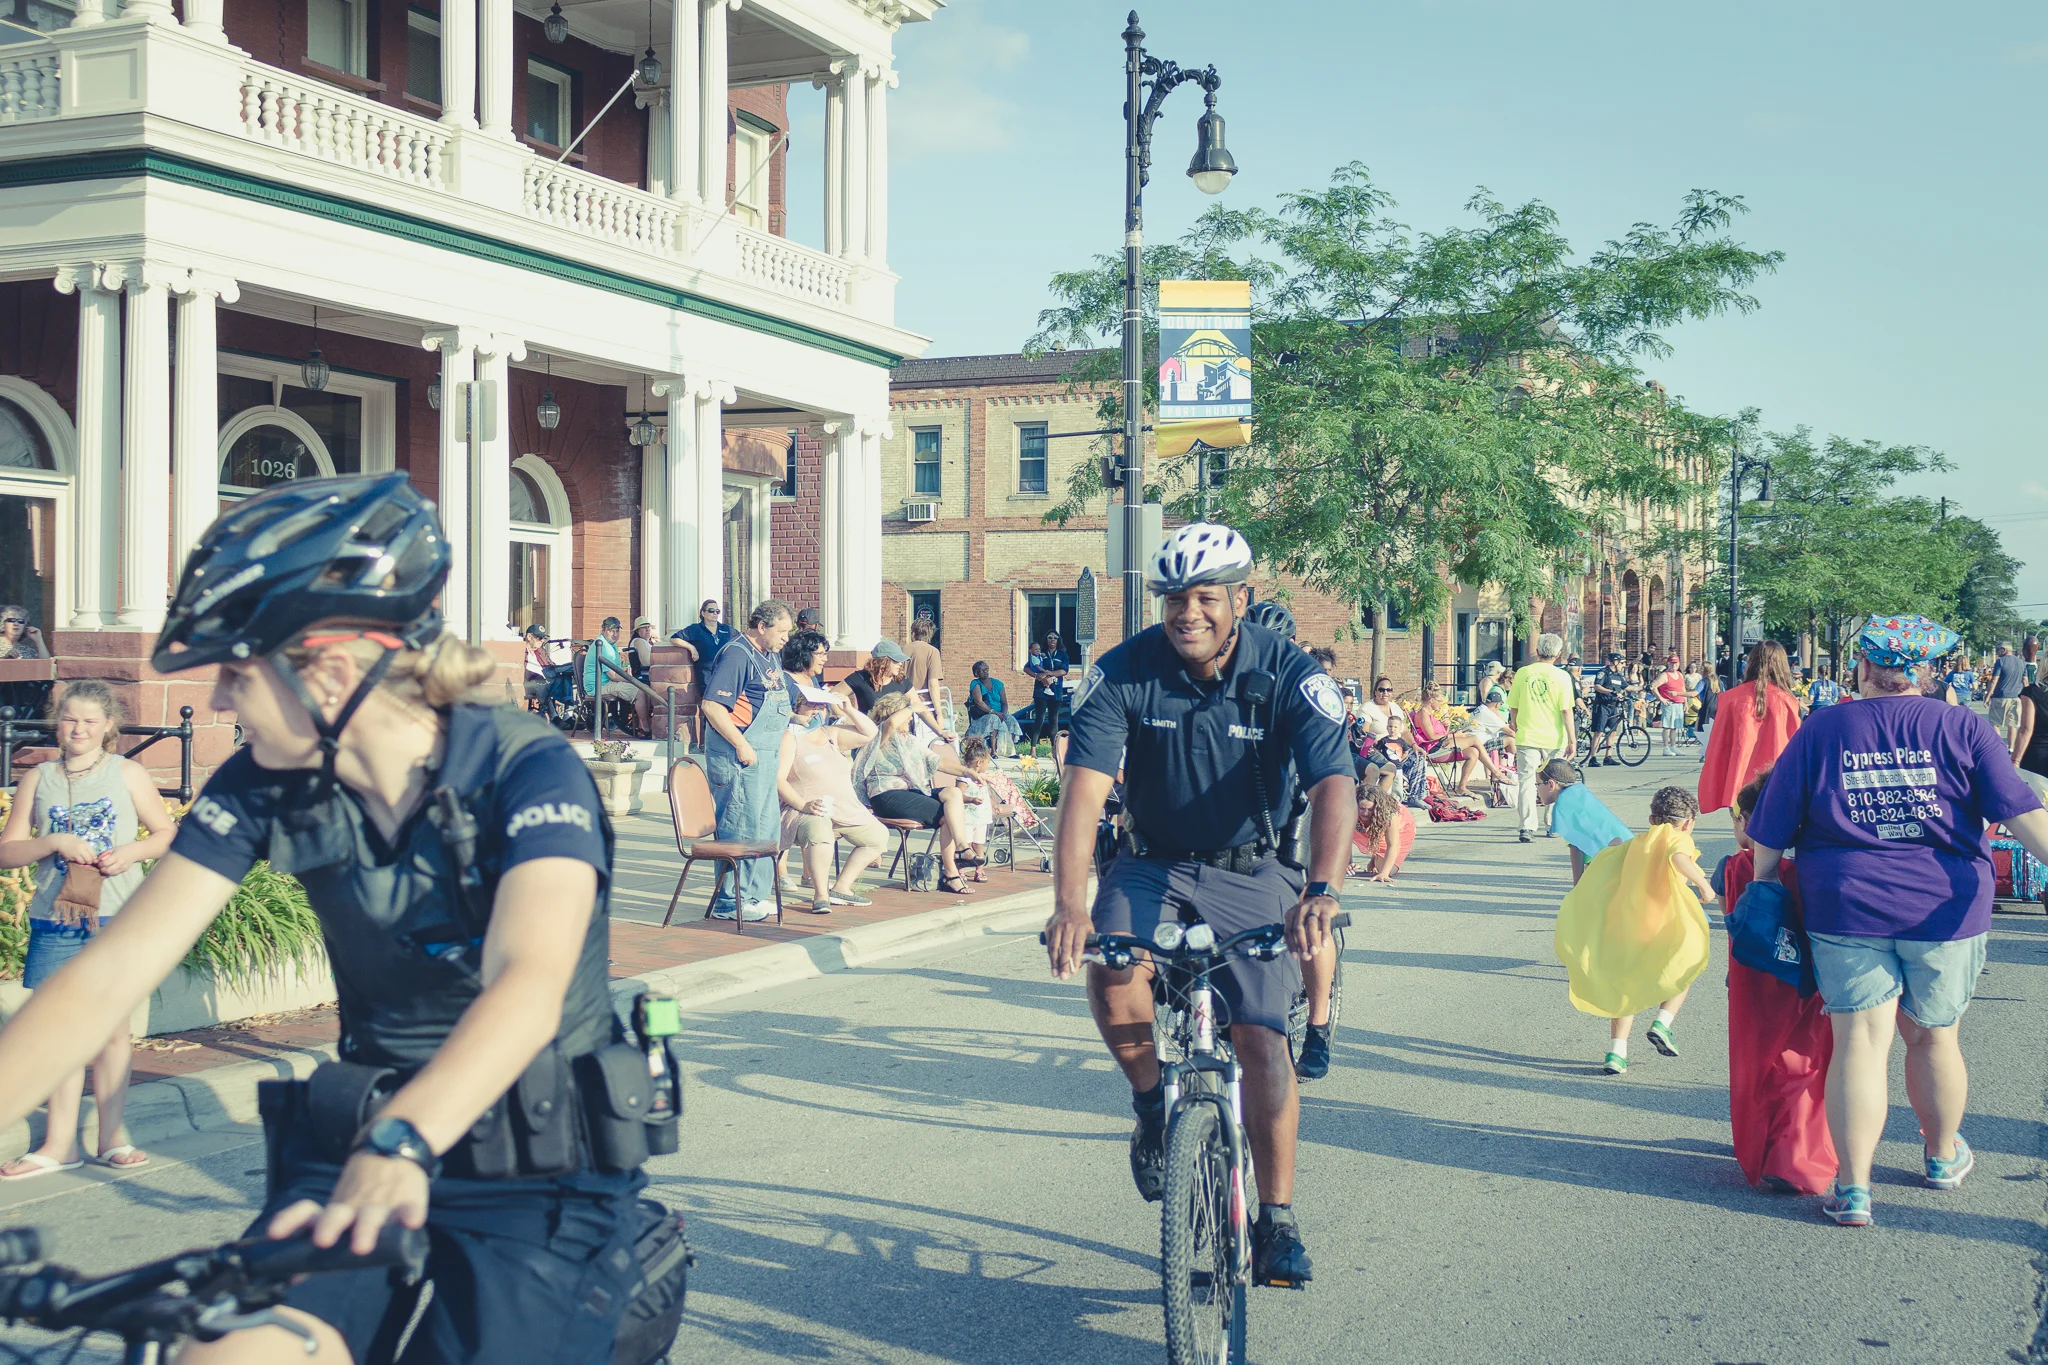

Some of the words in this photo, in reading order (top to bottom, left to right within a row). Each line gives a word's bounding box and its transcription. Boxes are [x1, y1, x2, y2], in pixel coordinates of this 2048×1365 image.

[1167, 316, 1243, 329] DOWNTOWN
[1167, 406, 1197, 417] PORT
[1205, 405, 1244, 416] HURON
[251, 459, 296, 479] 1026
[1143, 717, 1150, 726] C.
[1152, 719, 1177, 729] SMITH
[1228, 724, 1265, 740] POLICE
[1843, 749, 1894, 769] Cypress
[1896, 747, 1931, 764] Place
[1845, 773, 1868, 786] Street
[1869, 771, 1903, 785] Outreach
[191, 795, 238, 836] ICE
[1851, 804, 1944, 823] 810-824-4835
[1878, 824, 1901, 833] United
[1888, 830, 1903, 838] Way
